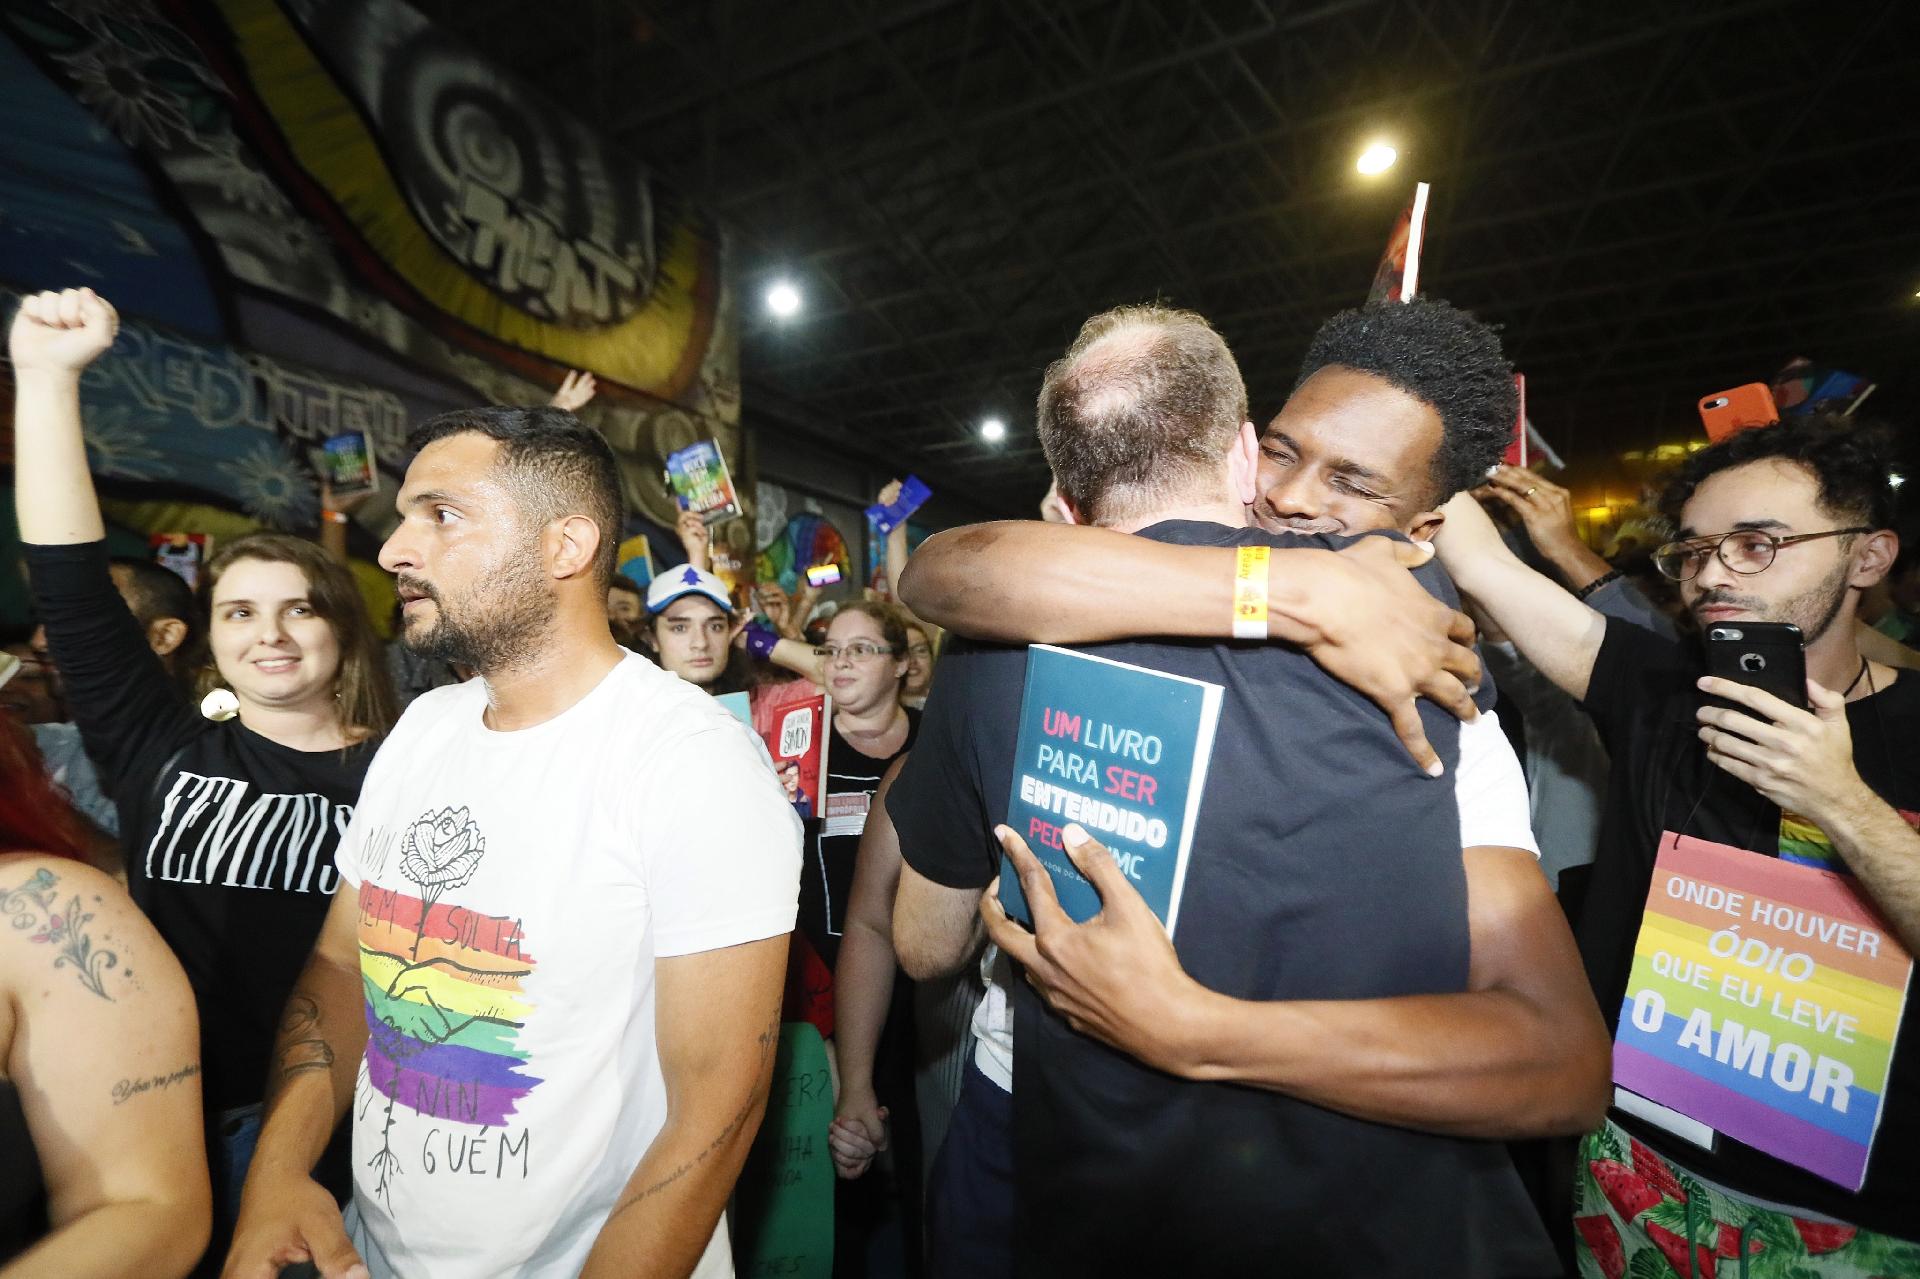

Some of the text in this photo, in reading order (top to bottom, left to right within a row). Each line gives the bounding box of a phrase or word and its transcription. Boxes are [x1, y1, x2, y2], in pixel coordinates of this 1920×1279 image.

[1043, 707, 1163, 765] UM LIVRO
[1037, 745, 1158, 806] PARA SER
[1019, 774, 1168, 849] ENTENDIDO
[1029, 818, 1145, 881] PED MC
[442, 906, 522, 961] SOLTA
[1666, 876, 1882, 959] ONDE HOUVER
[1708, 924, 1816, 984] ÓDIO
[1652, 951, 1859, 1045] QUE EU LEVE
[1631, 988, 1857, 1114] O AMOR
[415, 1076, 480, 1121] NIN
[423, 1125, 529, 1179] GUÉM
